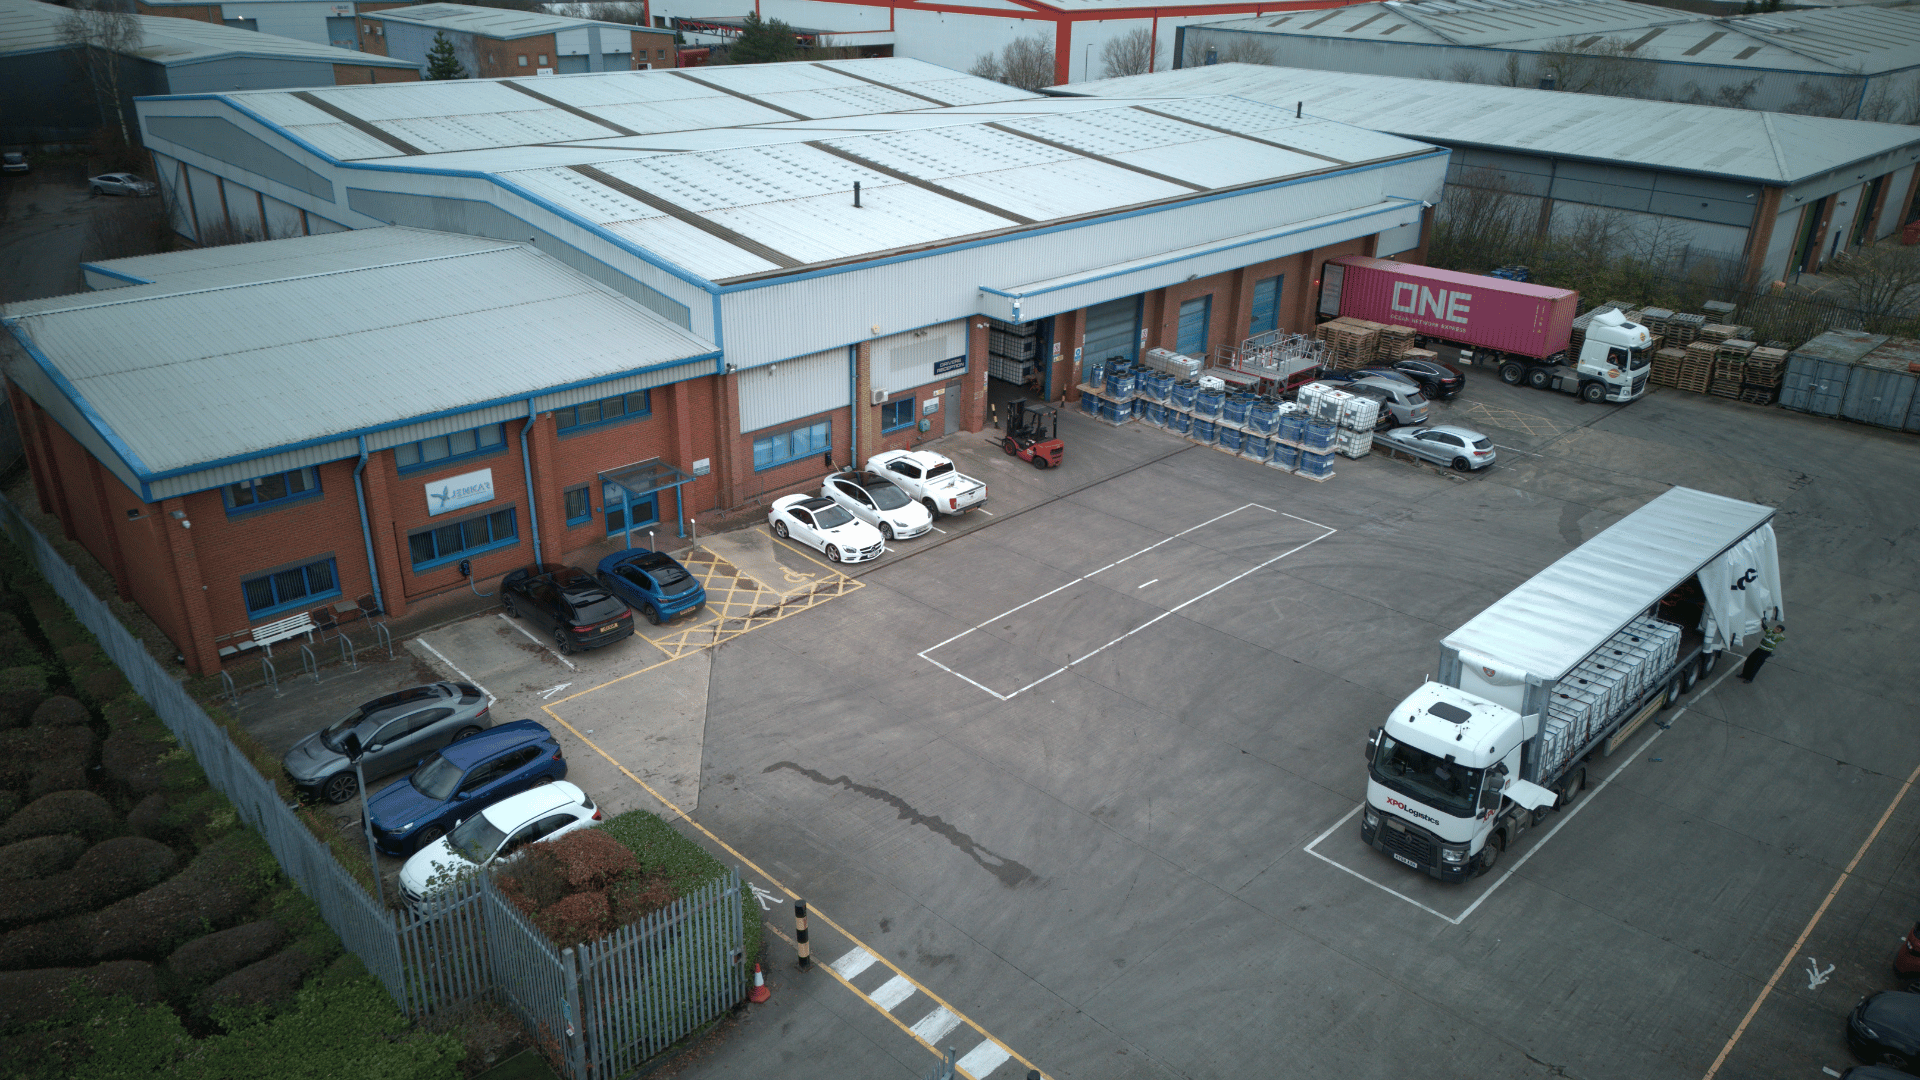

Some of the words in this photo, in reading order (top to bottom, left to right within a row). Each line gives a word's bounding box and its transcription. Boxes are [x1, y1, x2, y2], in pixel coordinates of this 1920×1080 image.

[1391, 281, 1472, 324] ONE
[1390, 313, 1409, 322] OCEAN
[1411, 318, 1439, 328] NETWORK
[1441, 323, 1467, 334] EXPRESS
[936, 362, 965, 374] RECEPTION
